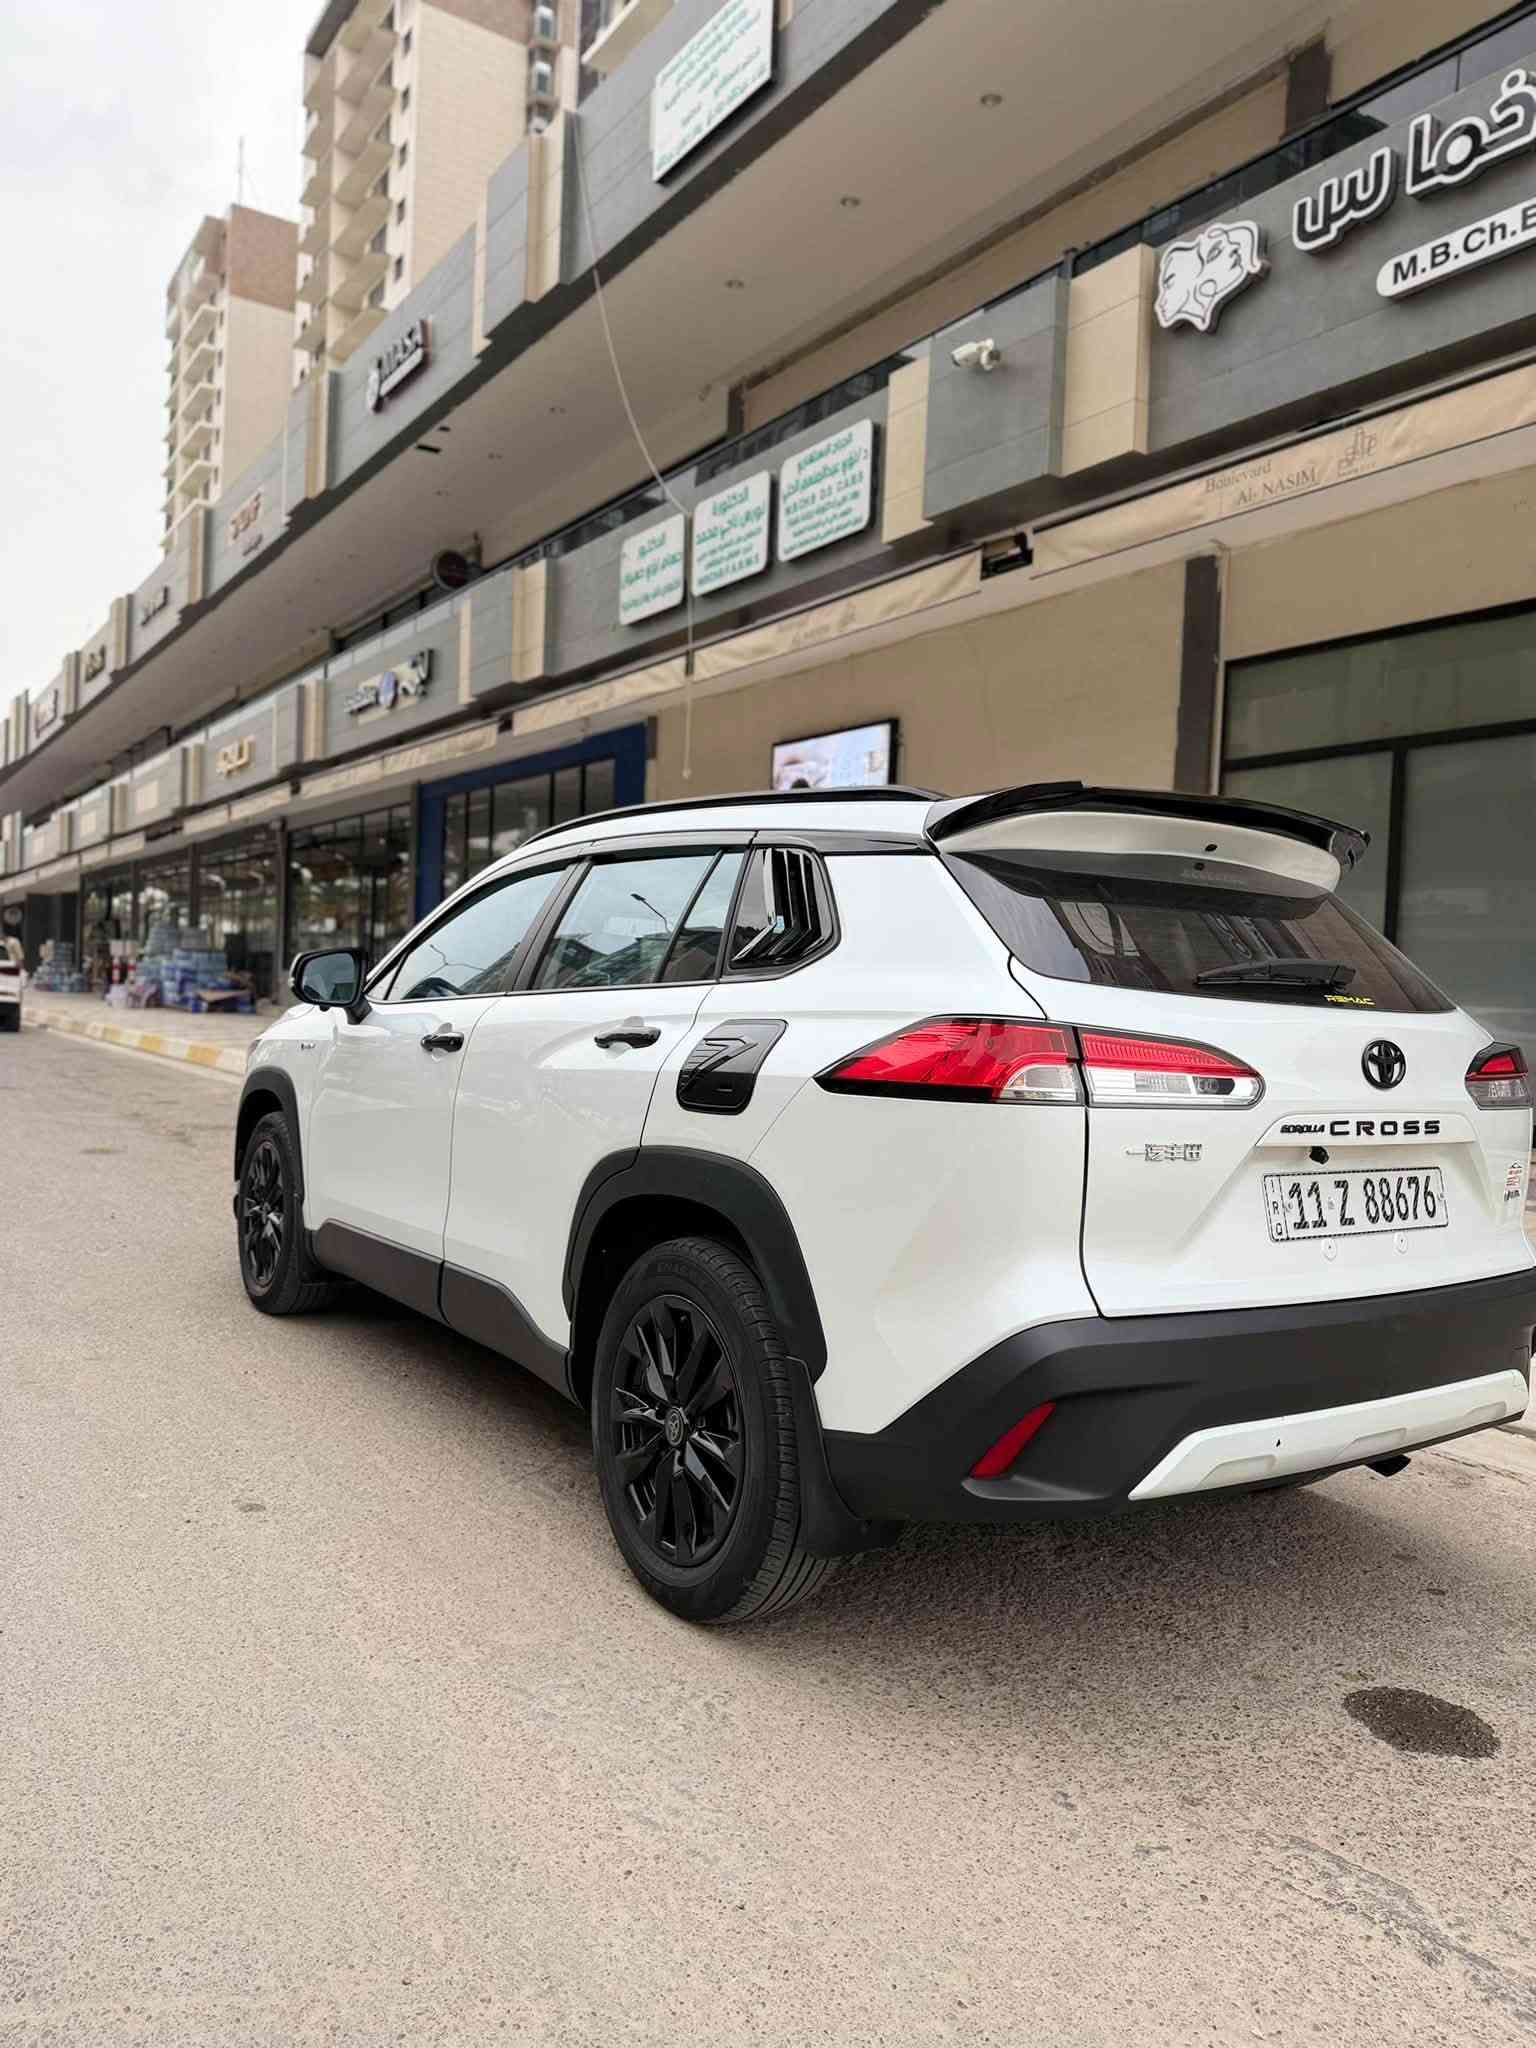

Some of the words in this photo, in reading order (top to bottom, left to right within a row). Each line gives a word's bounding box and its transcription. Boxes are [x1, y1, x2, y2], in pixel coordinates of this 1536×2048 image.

[1204, 459, 1273, 494] Boulevard
[1262, 467, 1319, 497] NASIM
[1330, 1120, 1441, 1137] CROSS
[1334, 1179, 1355, 1226] Z
[1362, 1175, 1437, 1225] 88676
